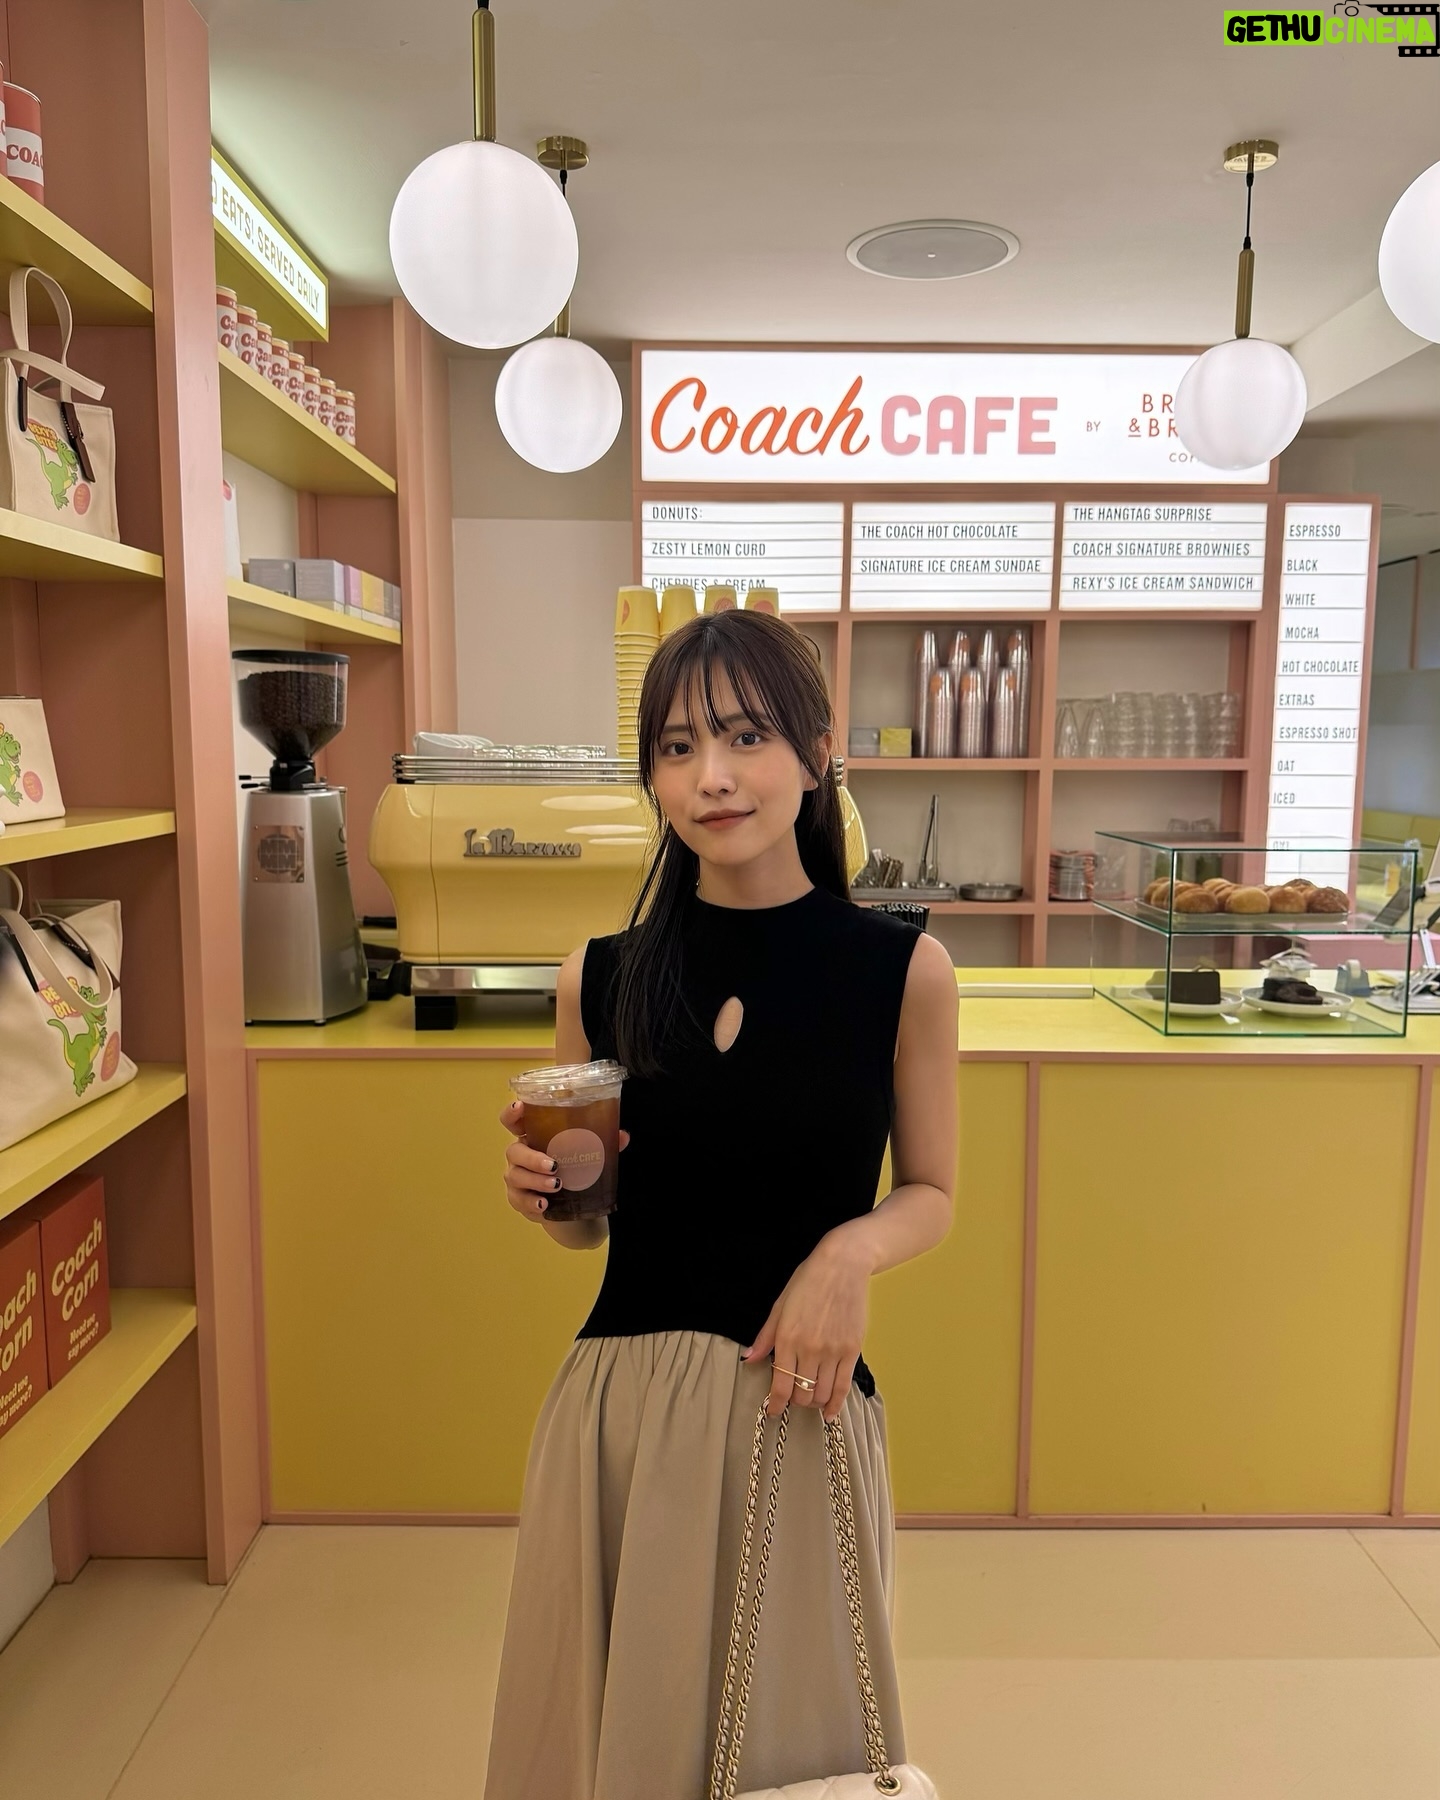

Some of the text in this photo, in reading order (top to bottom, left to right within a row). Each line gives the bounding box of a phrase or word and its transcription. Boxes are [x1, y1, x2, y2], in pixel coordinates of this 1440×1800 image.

[222, 185, 320, 313] EATS! SERVED DAILY
[1142, 394, 1174, 413] BR
[651, 375, 1058, 456] Coach CAFE
[1086, 421, 1101, 432] BY
[1128, 418, 1178, 437] &BR
[1169, 453, 1194, 463] CO
[652, 506, 703, 520] DONUTS:
[1073, 508, 1212, 521] THE HANGTAG SURPRISE
[861, 525, 1018, 538] THE COACH HOT CHOCOLATE
[1289, 524, 1341, 537] ESPRESSO
[652, 542, 766, 556] ZESTY LEMON CURD
[1073, 543, 1251, 556] COACH SIGNATURE BROWNIES
[860, 559, 1041, 573] SIGNATURE ICE CREAM SUNDAE
[1287, 559, 1318, 572] BLACK
[1073, 577, 1253, 590] REXY'S ICE CREAM SANDWICH
[1285, 593, 1316, 606] WHITE
[1285, 627, 1319, 639] MOCHA
[1282, 661, 1358, 673] HOT CHOCOLATE
[1279, 694, 1315, 706] EXTRAS
[1279, 727, 1357, 739] ESPRESSO SHOT
[1277, 760, 1295, 772] OAT
[1273, 793, 1295, 804] ICED
[51, 1217, 102, 1297] Coach
[62, 1259, 99, 1321] Corn
[0, 1269, 37, 1336] ach
[0, 1315, 33, 1373] orn
